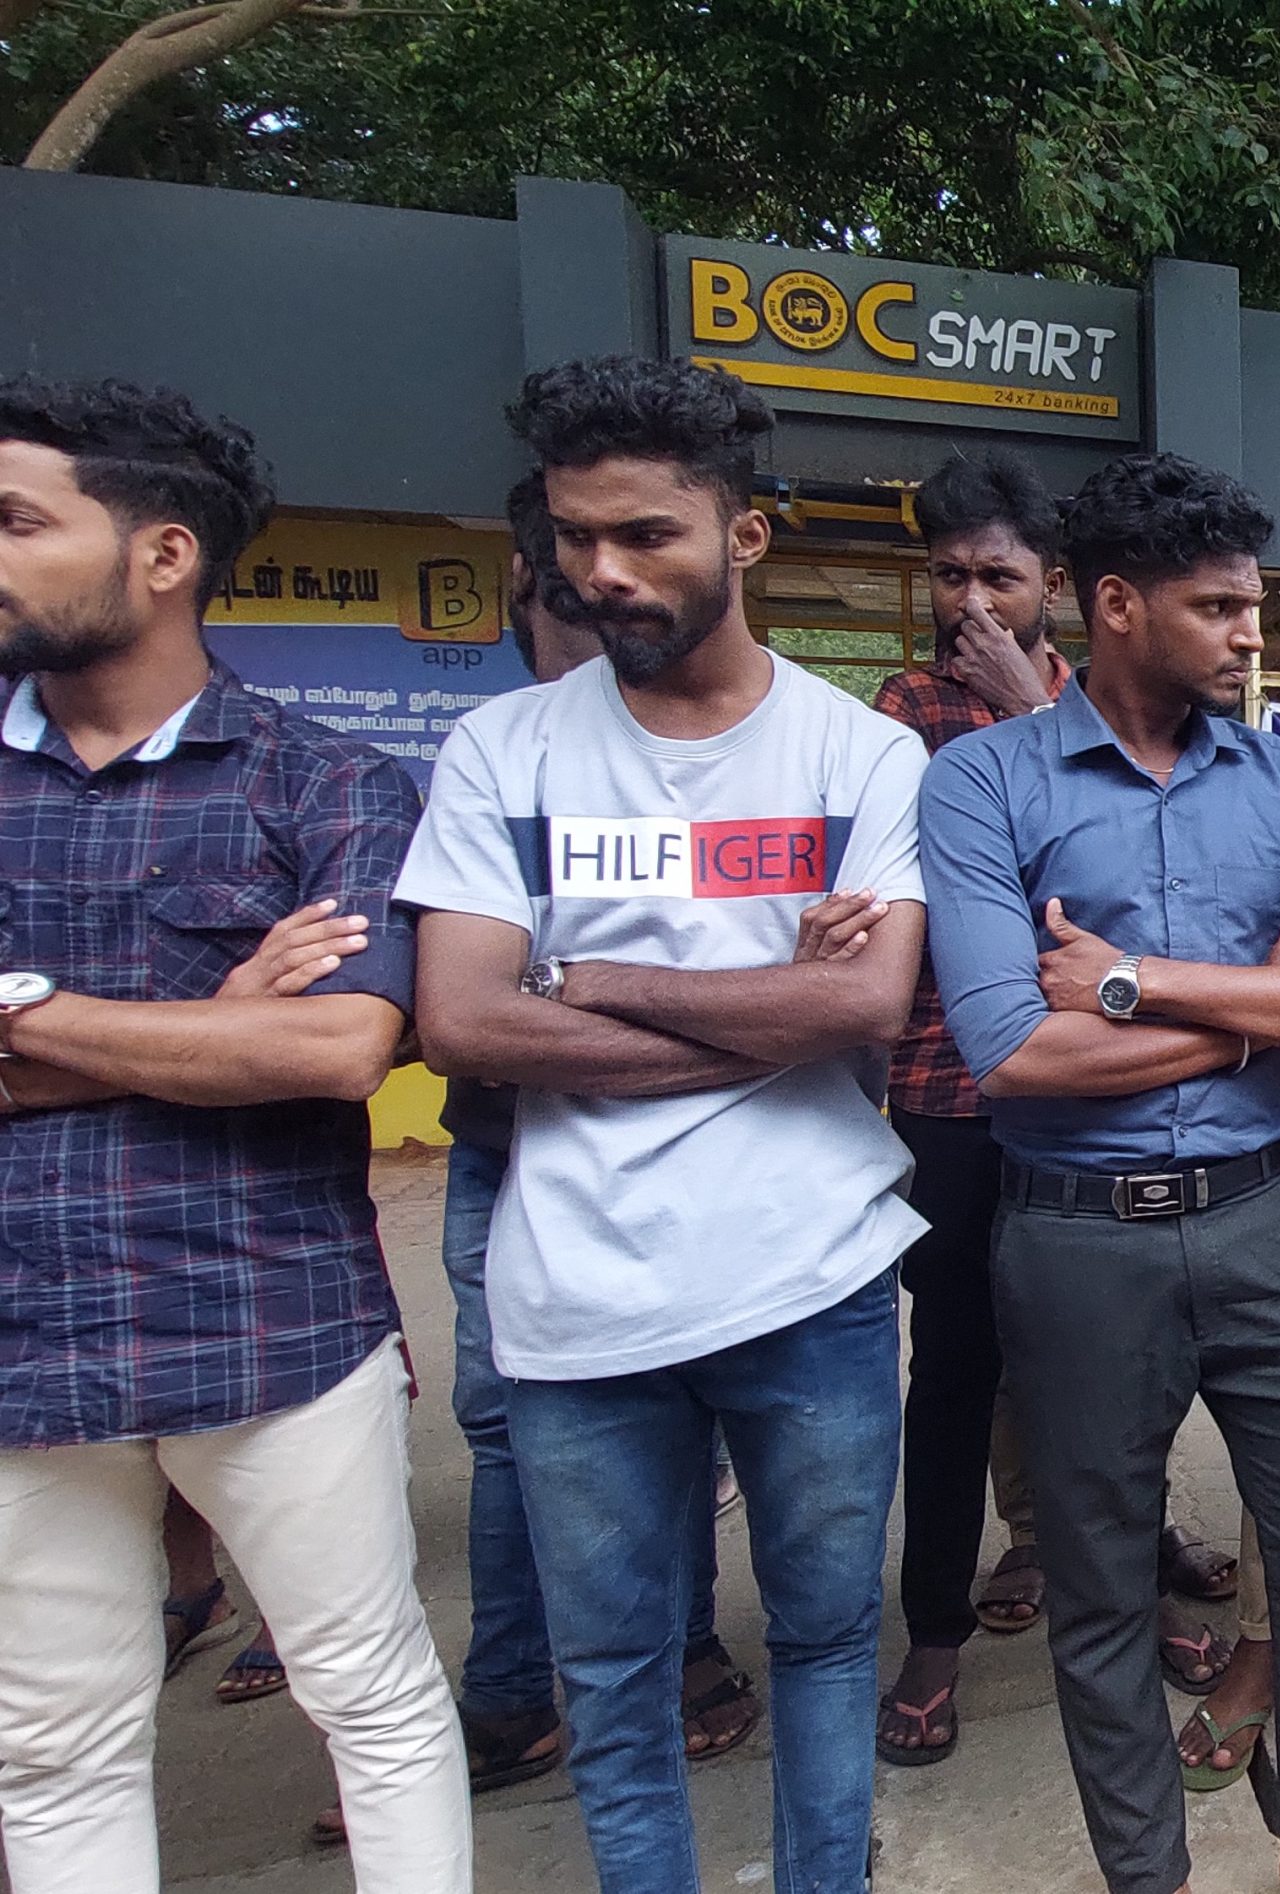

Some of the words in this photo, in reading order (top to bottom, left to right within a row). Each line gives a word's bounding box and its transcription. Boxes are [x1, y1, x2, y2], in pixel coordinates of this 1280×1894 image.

[690, 257, 917, 363] BOC
[925, 310, 1117, 383] SMART
[994, 390, 1035, 405] 24x7
[1042, 395, 1110, 414] banking
[422, 645, 484, 671] app
[562, 831, 817, 883] HILFIGER
